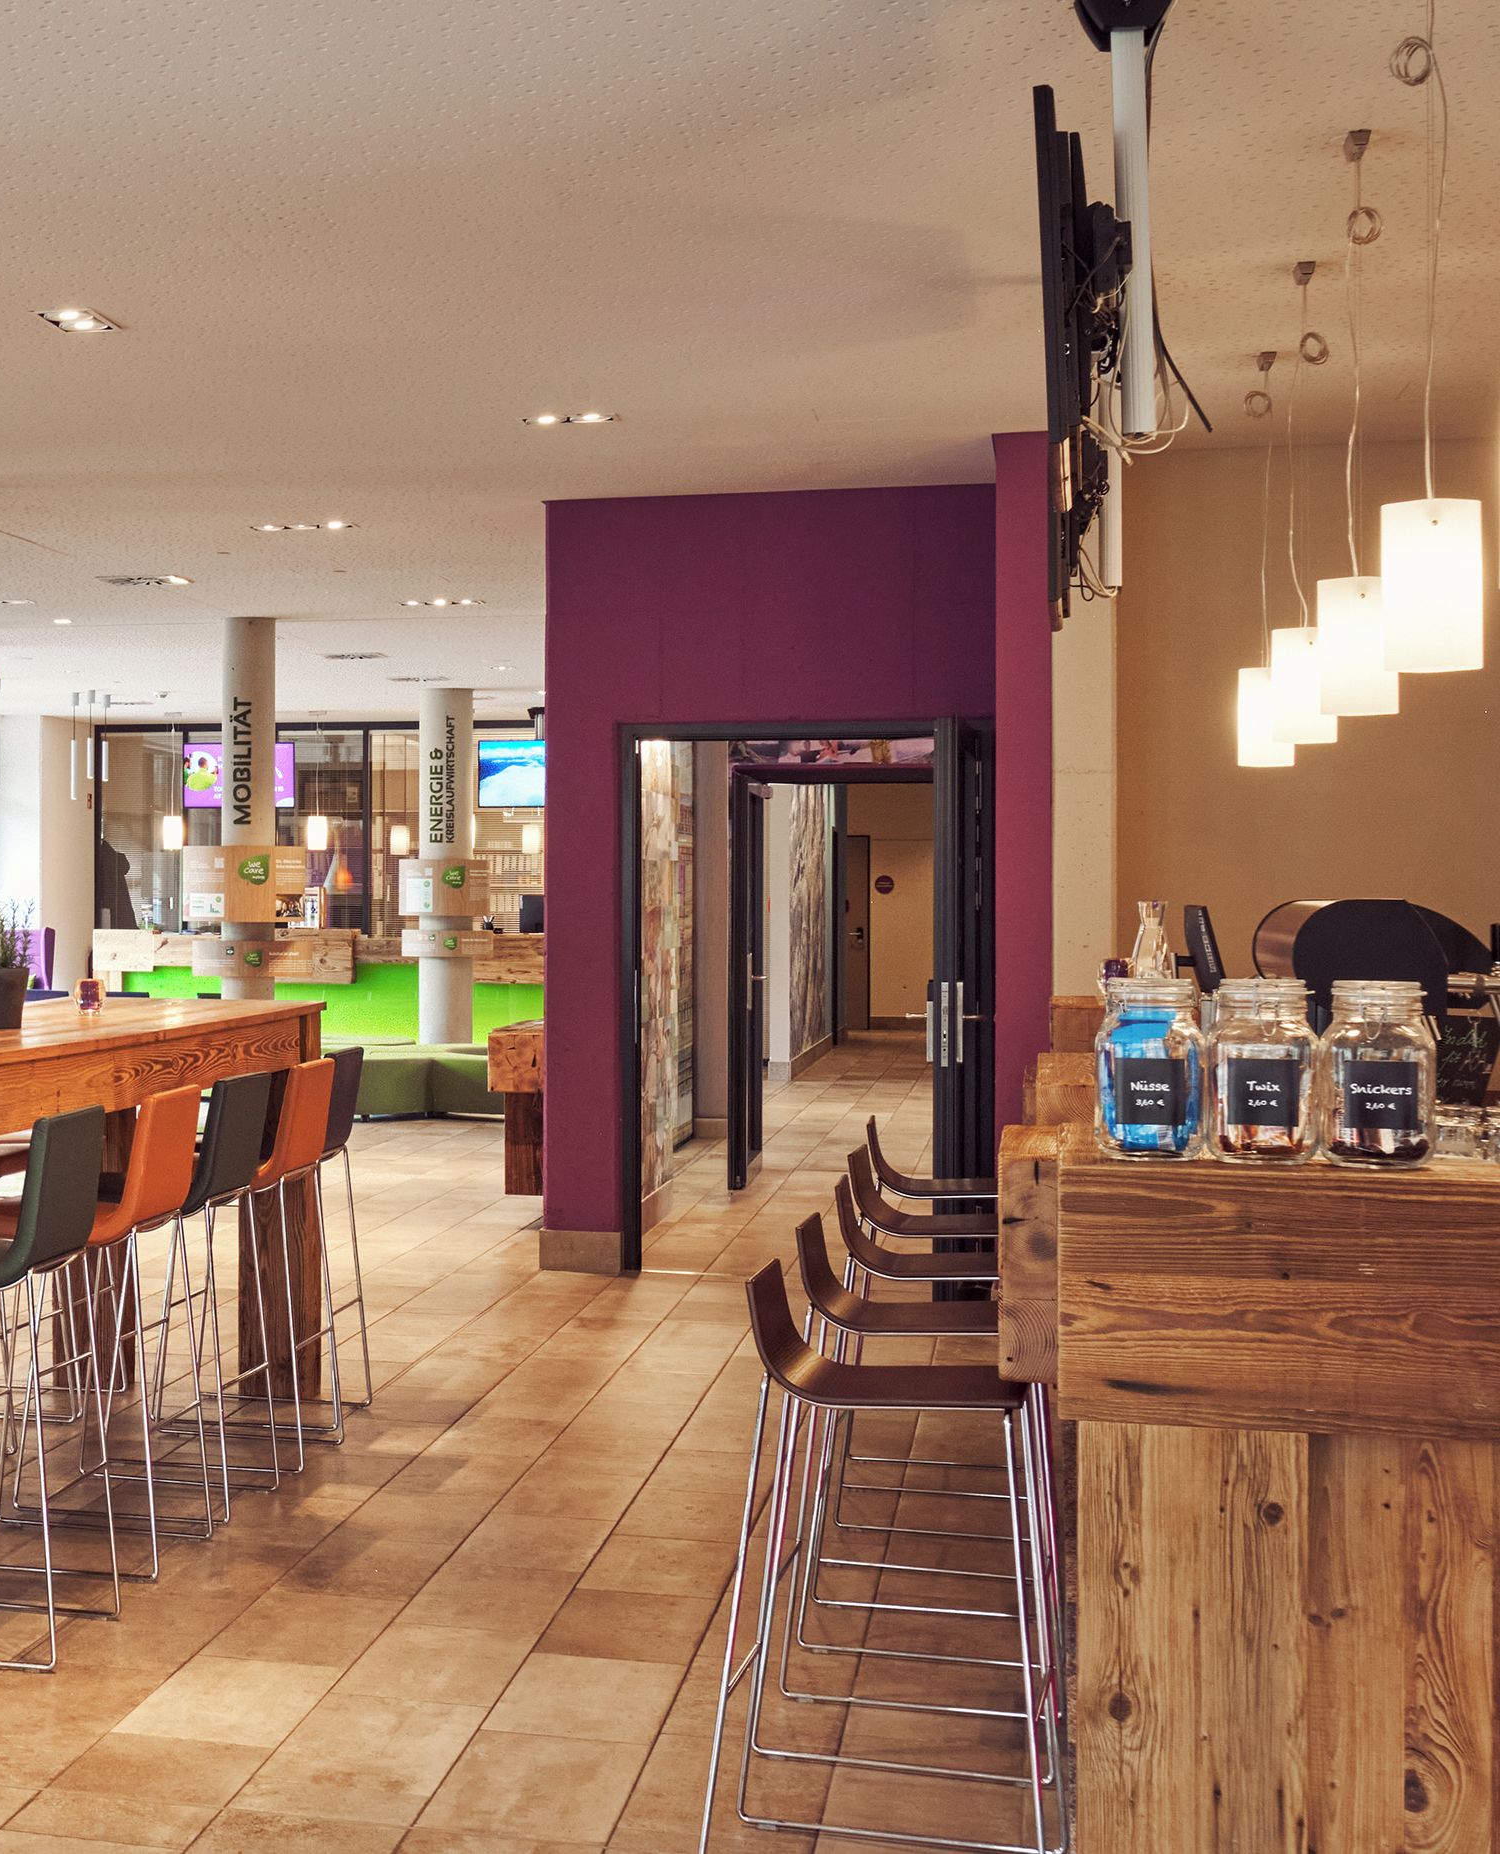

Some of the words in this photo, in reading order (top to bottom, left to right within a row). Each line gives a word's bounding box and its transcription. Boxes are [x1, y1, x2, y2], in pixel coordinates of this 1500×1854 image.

[430, 748, 443, 760] &
[230, 697, 252, 825] MOBILITÄT
[446, 715, 455, 843] KREISLAUFWIRTSCHAFT
[430, 765, 443, 843] ENERGIE
[1130, 1080, 1170, 1092] Nüsse
[1246, 1080, 1281, 1092] Twix
[1350, 1083, 1412, 1095] Snickers
[1156, 1099, 1165, 1107] €
[1248, 1099, 1268, 1107] 2,60
[1269, 1099, 1278, 1107] €
[1365, 1102, 1386, 1110] 2,60
[1387, 1102, 1397, 1110] €
